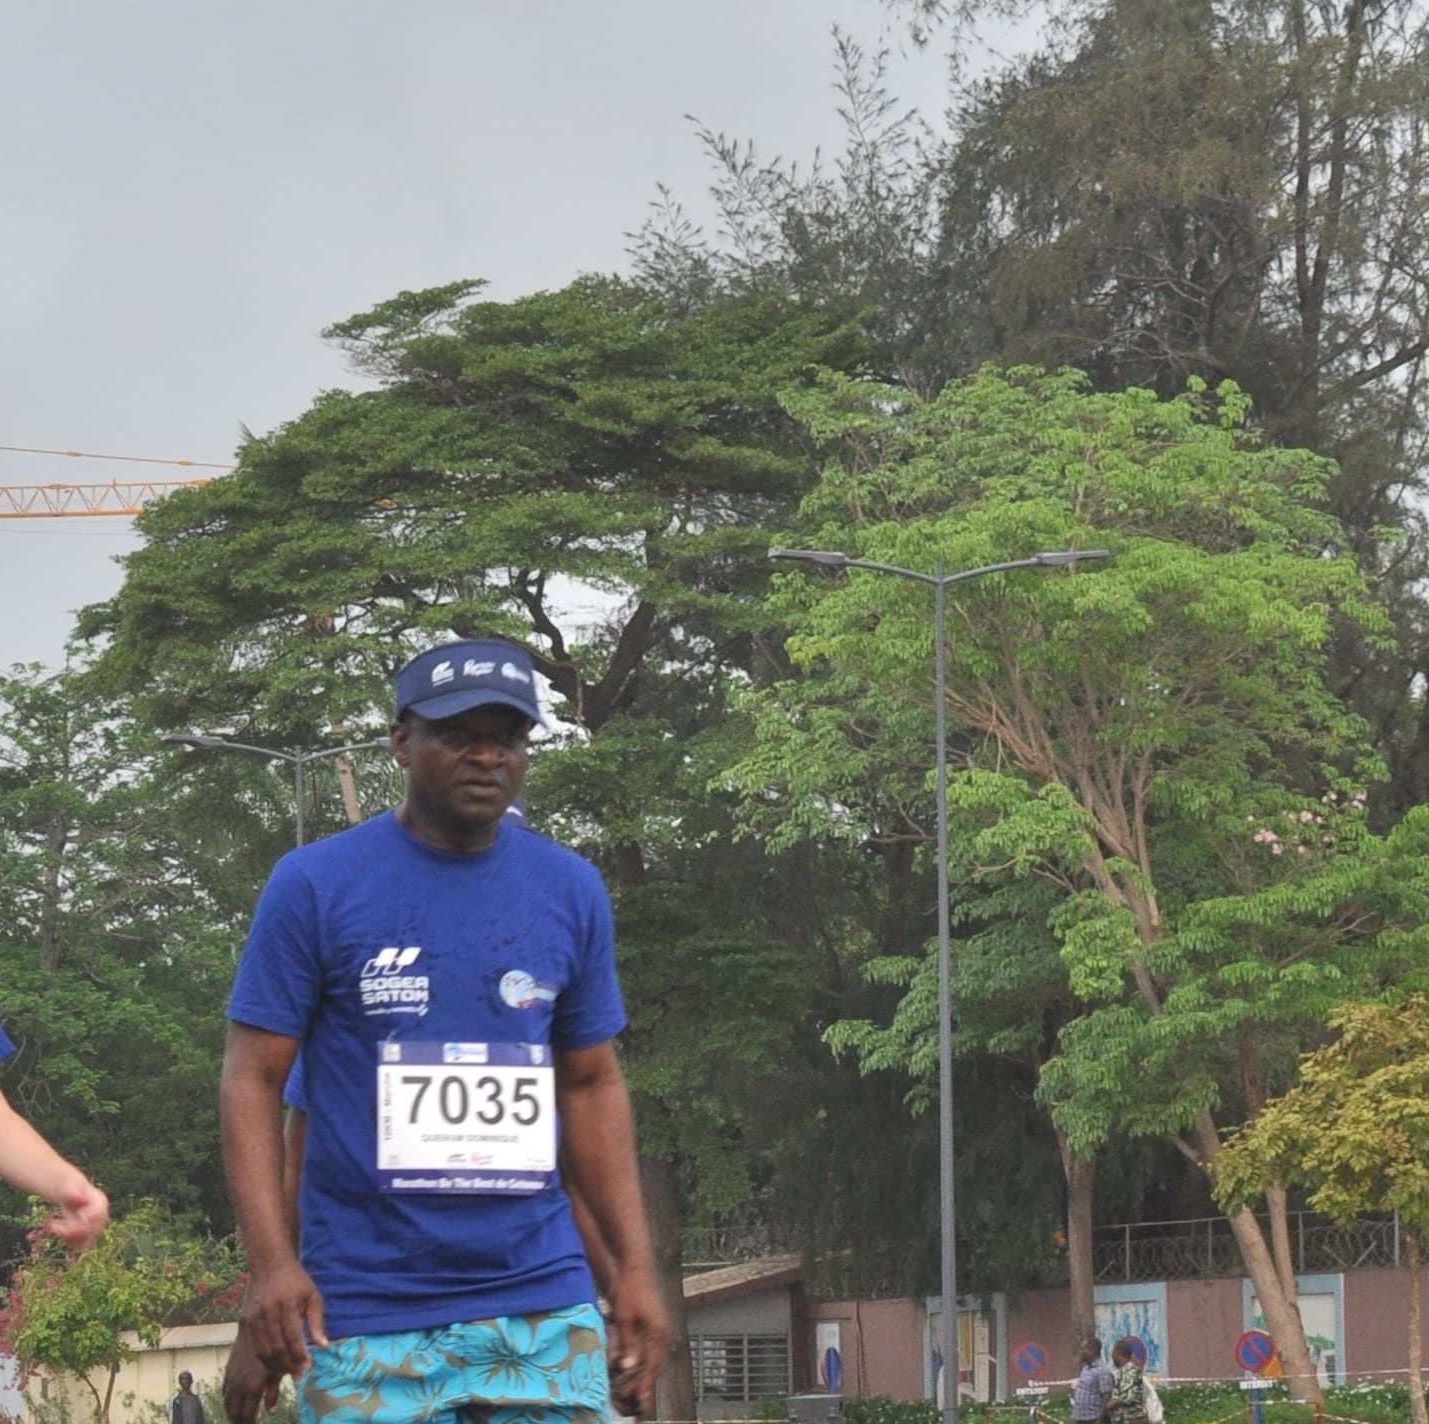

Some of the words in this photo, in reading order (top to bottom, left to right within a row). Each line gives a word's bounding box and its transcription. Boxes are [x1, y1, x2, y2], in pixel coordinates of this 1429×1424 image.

[360, 976, 429, 992] SOGEA
[362, 989, 429, 1005] SATOM
[401, 1076, 541, 1126] 7035
